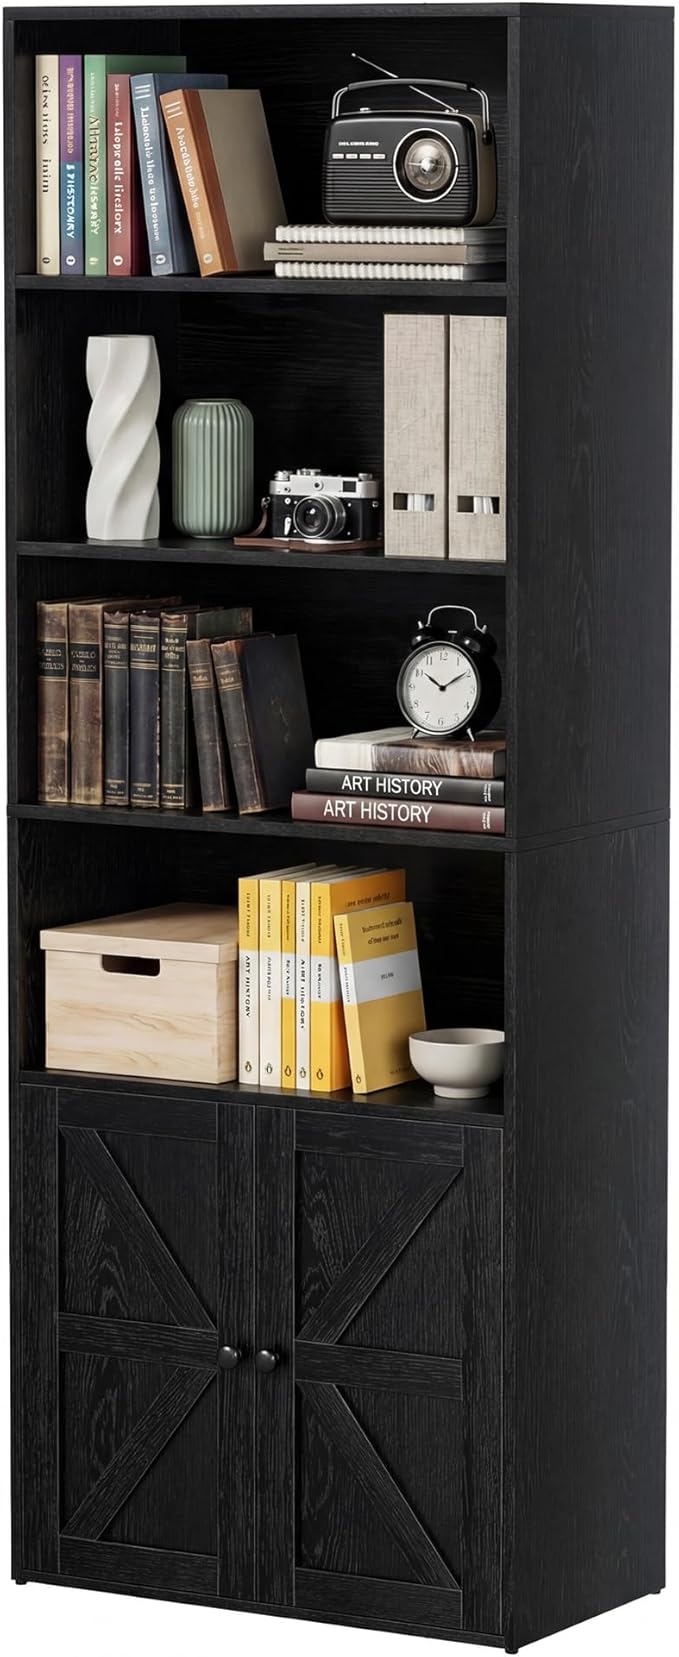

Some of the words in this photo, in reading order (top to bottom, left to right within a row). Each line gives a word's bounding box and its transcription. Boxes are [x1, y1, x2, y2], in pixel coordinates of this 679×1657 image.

[426, 656, 433, 665] 11
[440, 652, 448, 661] 12
[466, 668, 471, 678] 2
[413, 700, 419, 708] 8
[424, 711, 430, 720] 7
[454, 712, 460, 722] 5
[437, 717, 444, 726] 6
[341, 775, 373, 793] ART
[376, 777, 443, 797] HISTORY
[323, 799, 357, 819] ART
[360, 802, 433, 824] HISTORY
